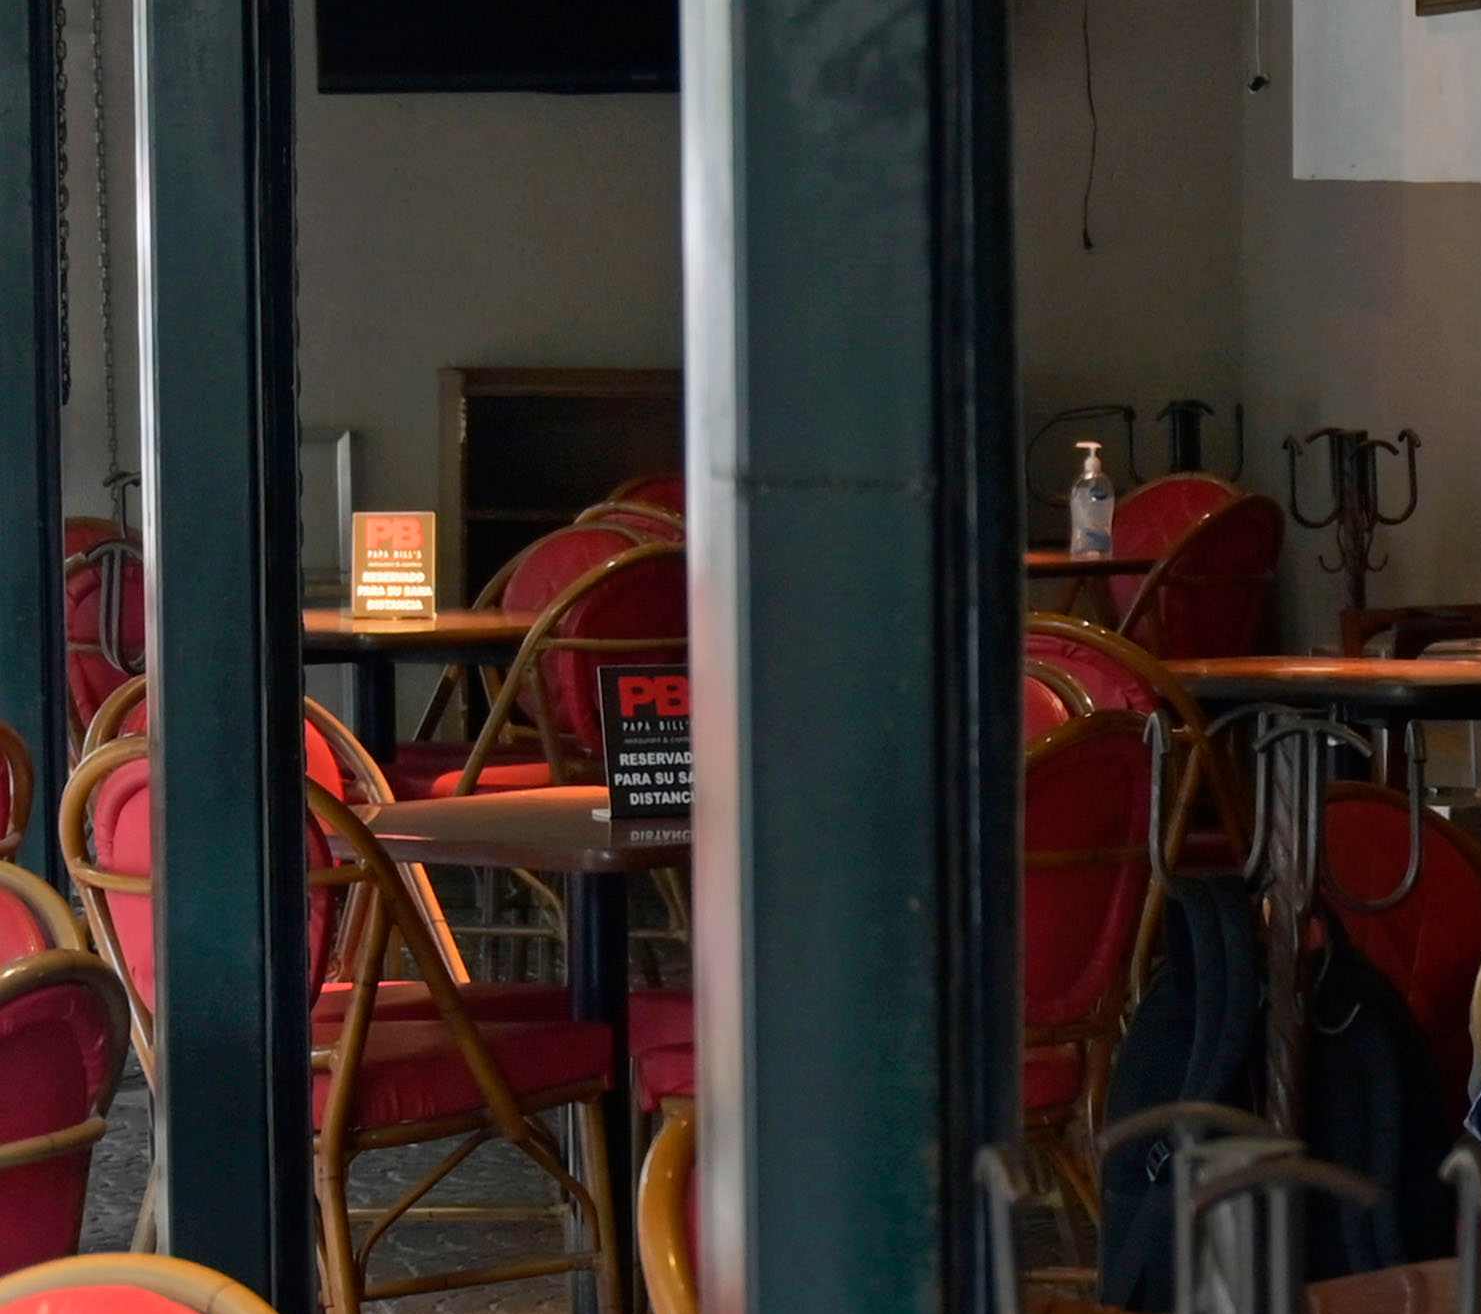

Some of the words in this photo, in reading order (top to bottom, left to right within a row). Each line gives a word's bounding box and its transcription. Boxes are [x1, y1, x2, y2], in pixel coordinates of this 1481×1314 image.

[366, 516, 424, 550] PB
[618, 675, 690, 718] PB
[622, 720, 651, 732] PAPA
[619, 750, 694, 766] RESERVAD
[614, 772, 651, 786] PARA
[655, 771, 674, 785] SU
[630, 791, 694, 805] DISTANC
